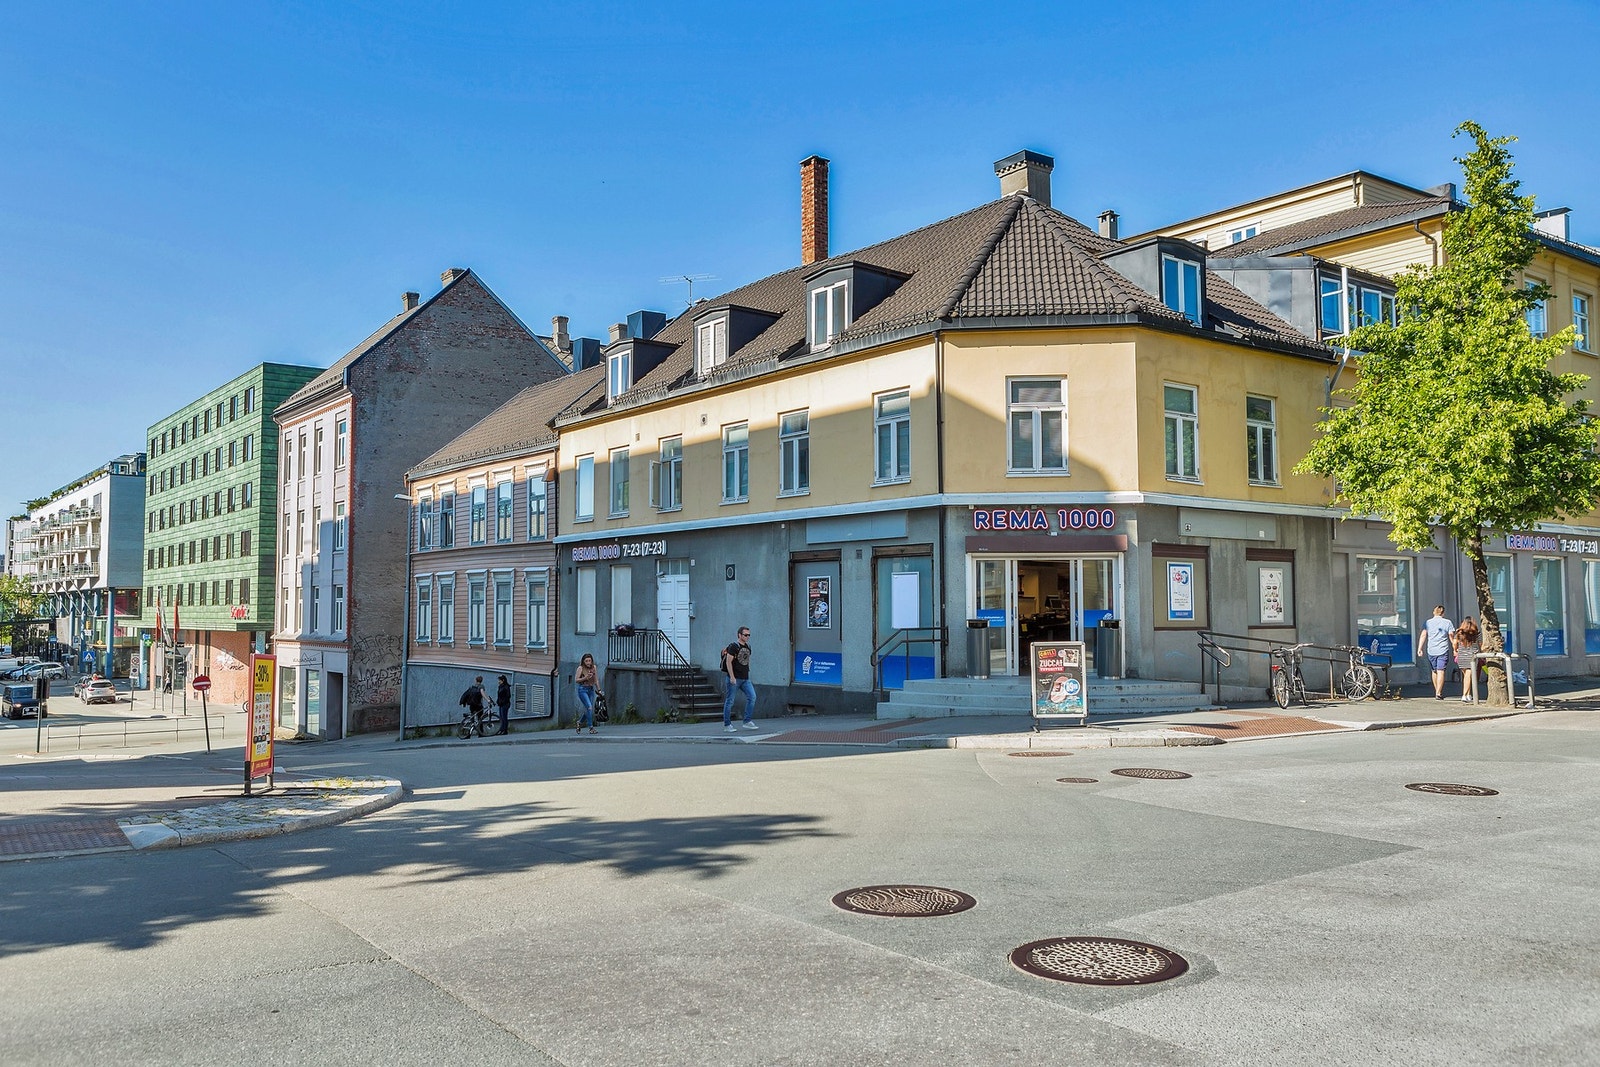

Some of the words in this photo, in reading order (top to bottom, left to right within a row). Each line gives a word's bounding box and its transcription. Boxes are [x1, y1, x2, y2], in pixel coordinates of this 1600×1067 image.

[974, 509, 1048, 529] REMA
[1058, 509, 1115, 529] 1000
[622, 543, 640, 556] 7-23
[641, 540, 667, 556] (7-23)
[1509, 535, 1535, 550] REMA
[1537, 536, 1557, 551] 1000
[1560, 539, 1577, 552] 7-23
[1578, 539, 1598, 554] (7-23)
[572, 547, 598, 561] REMA
[598, 544, 620, 559] 1000
